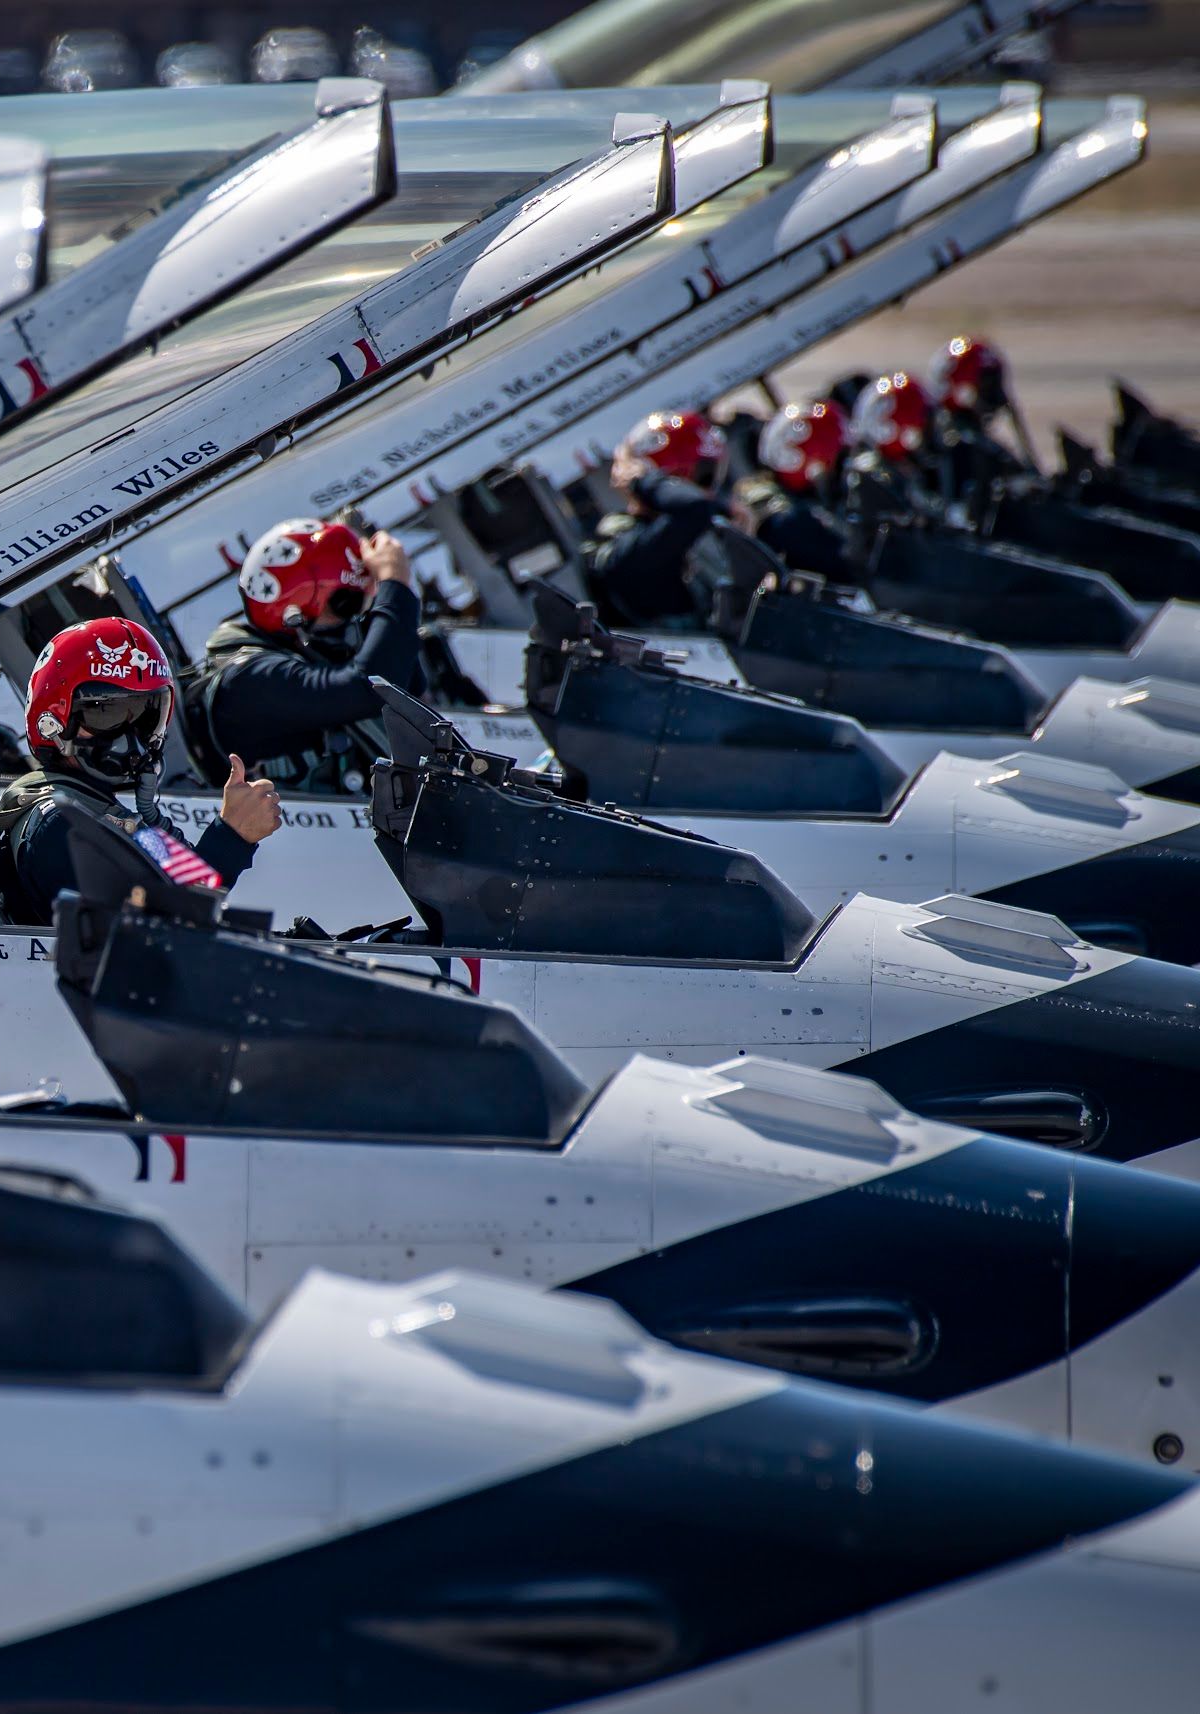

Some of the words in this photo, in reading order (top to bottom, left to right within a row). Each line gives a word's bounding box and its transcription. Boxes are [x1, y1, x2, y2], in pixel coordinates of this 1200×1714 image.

[309, 467, 378, 507] SSgt
[380, 400, 499, 468] Nicholas
[500, 328, 623, 400] Martinez
[112, 440, 220, 497] Wiles
[90, 663, 132, 678] USAF
